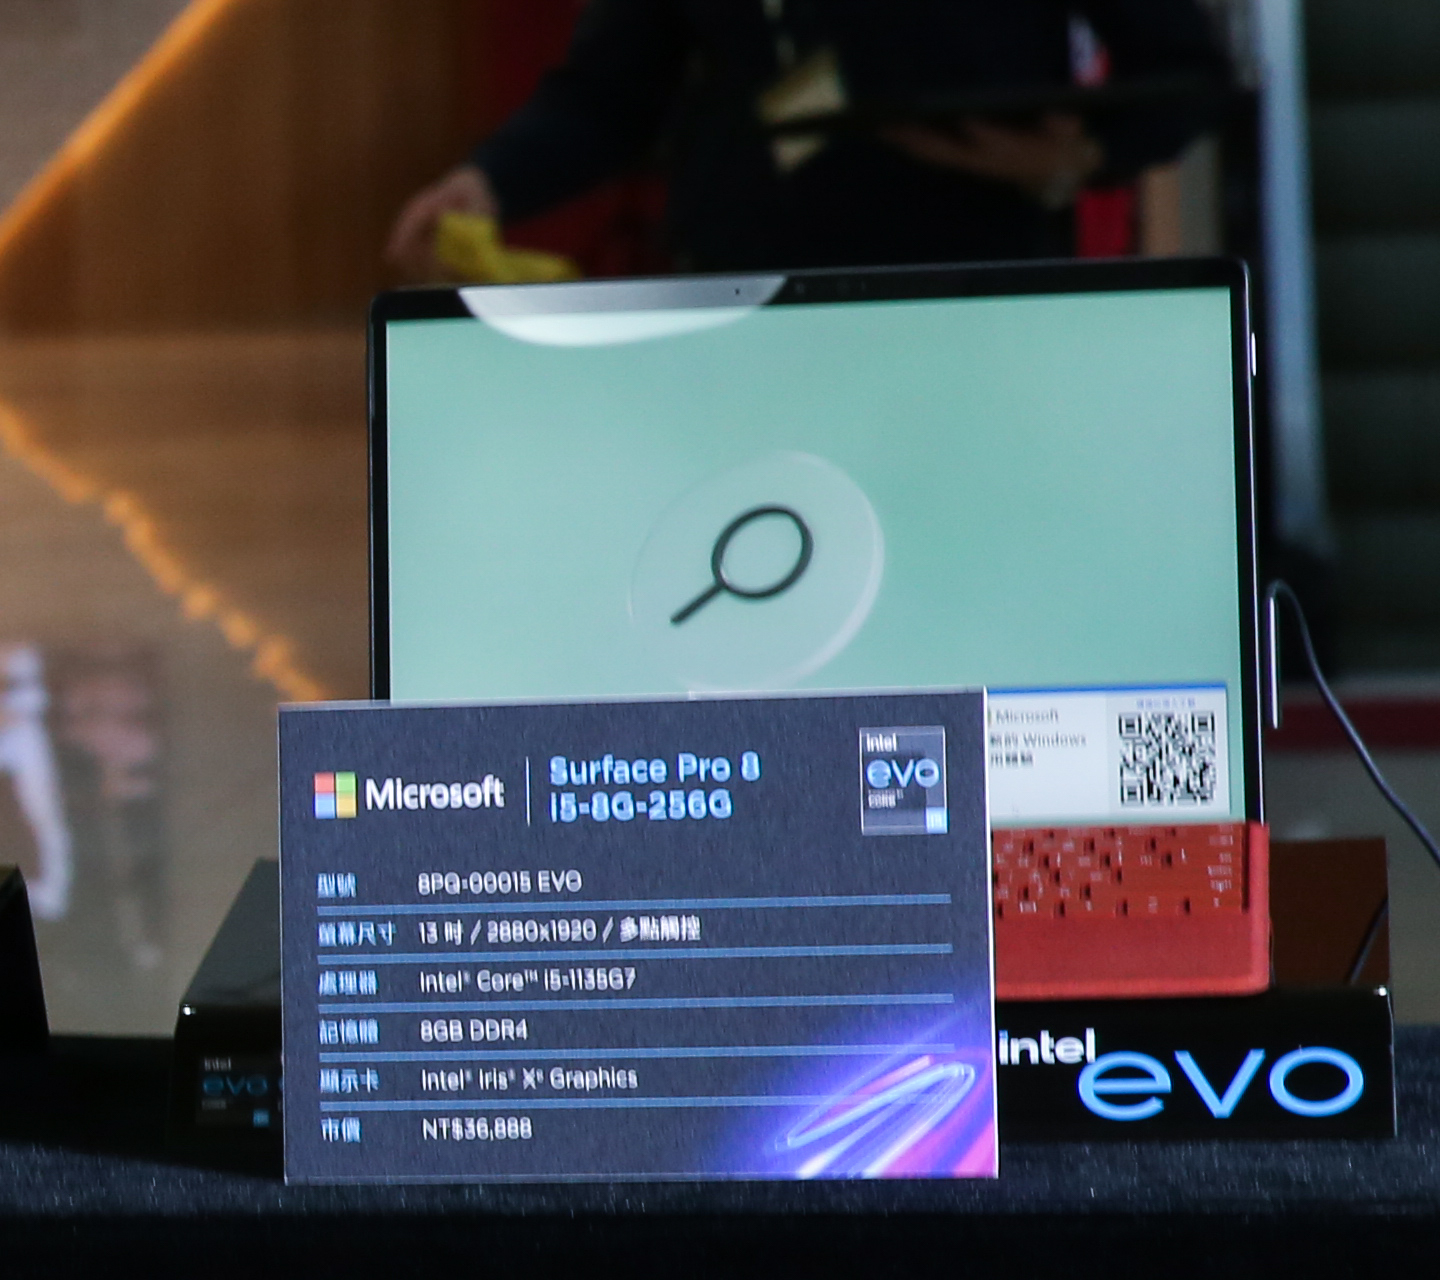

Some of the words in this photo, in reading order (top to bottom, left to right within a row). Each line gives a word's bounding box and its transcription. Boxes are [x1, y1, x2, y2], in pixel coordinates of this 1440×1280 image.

[550, 754, 667, 786] Surface
[678, 752, 731, 783] Pro
[867, 758, 939, 789] evo
[366, 774, 505, 812] Microsoft
[538, 870, 583, 893] EVO
[420, 1019, 464, 1043] 8GB
[470, 1019, 528, 1042] DDR4
[998, 1028, 1096, 1066] intel
[550, 1067, 638, 1093] Graphics
[1079, 1047, 1364, 1121] evo
